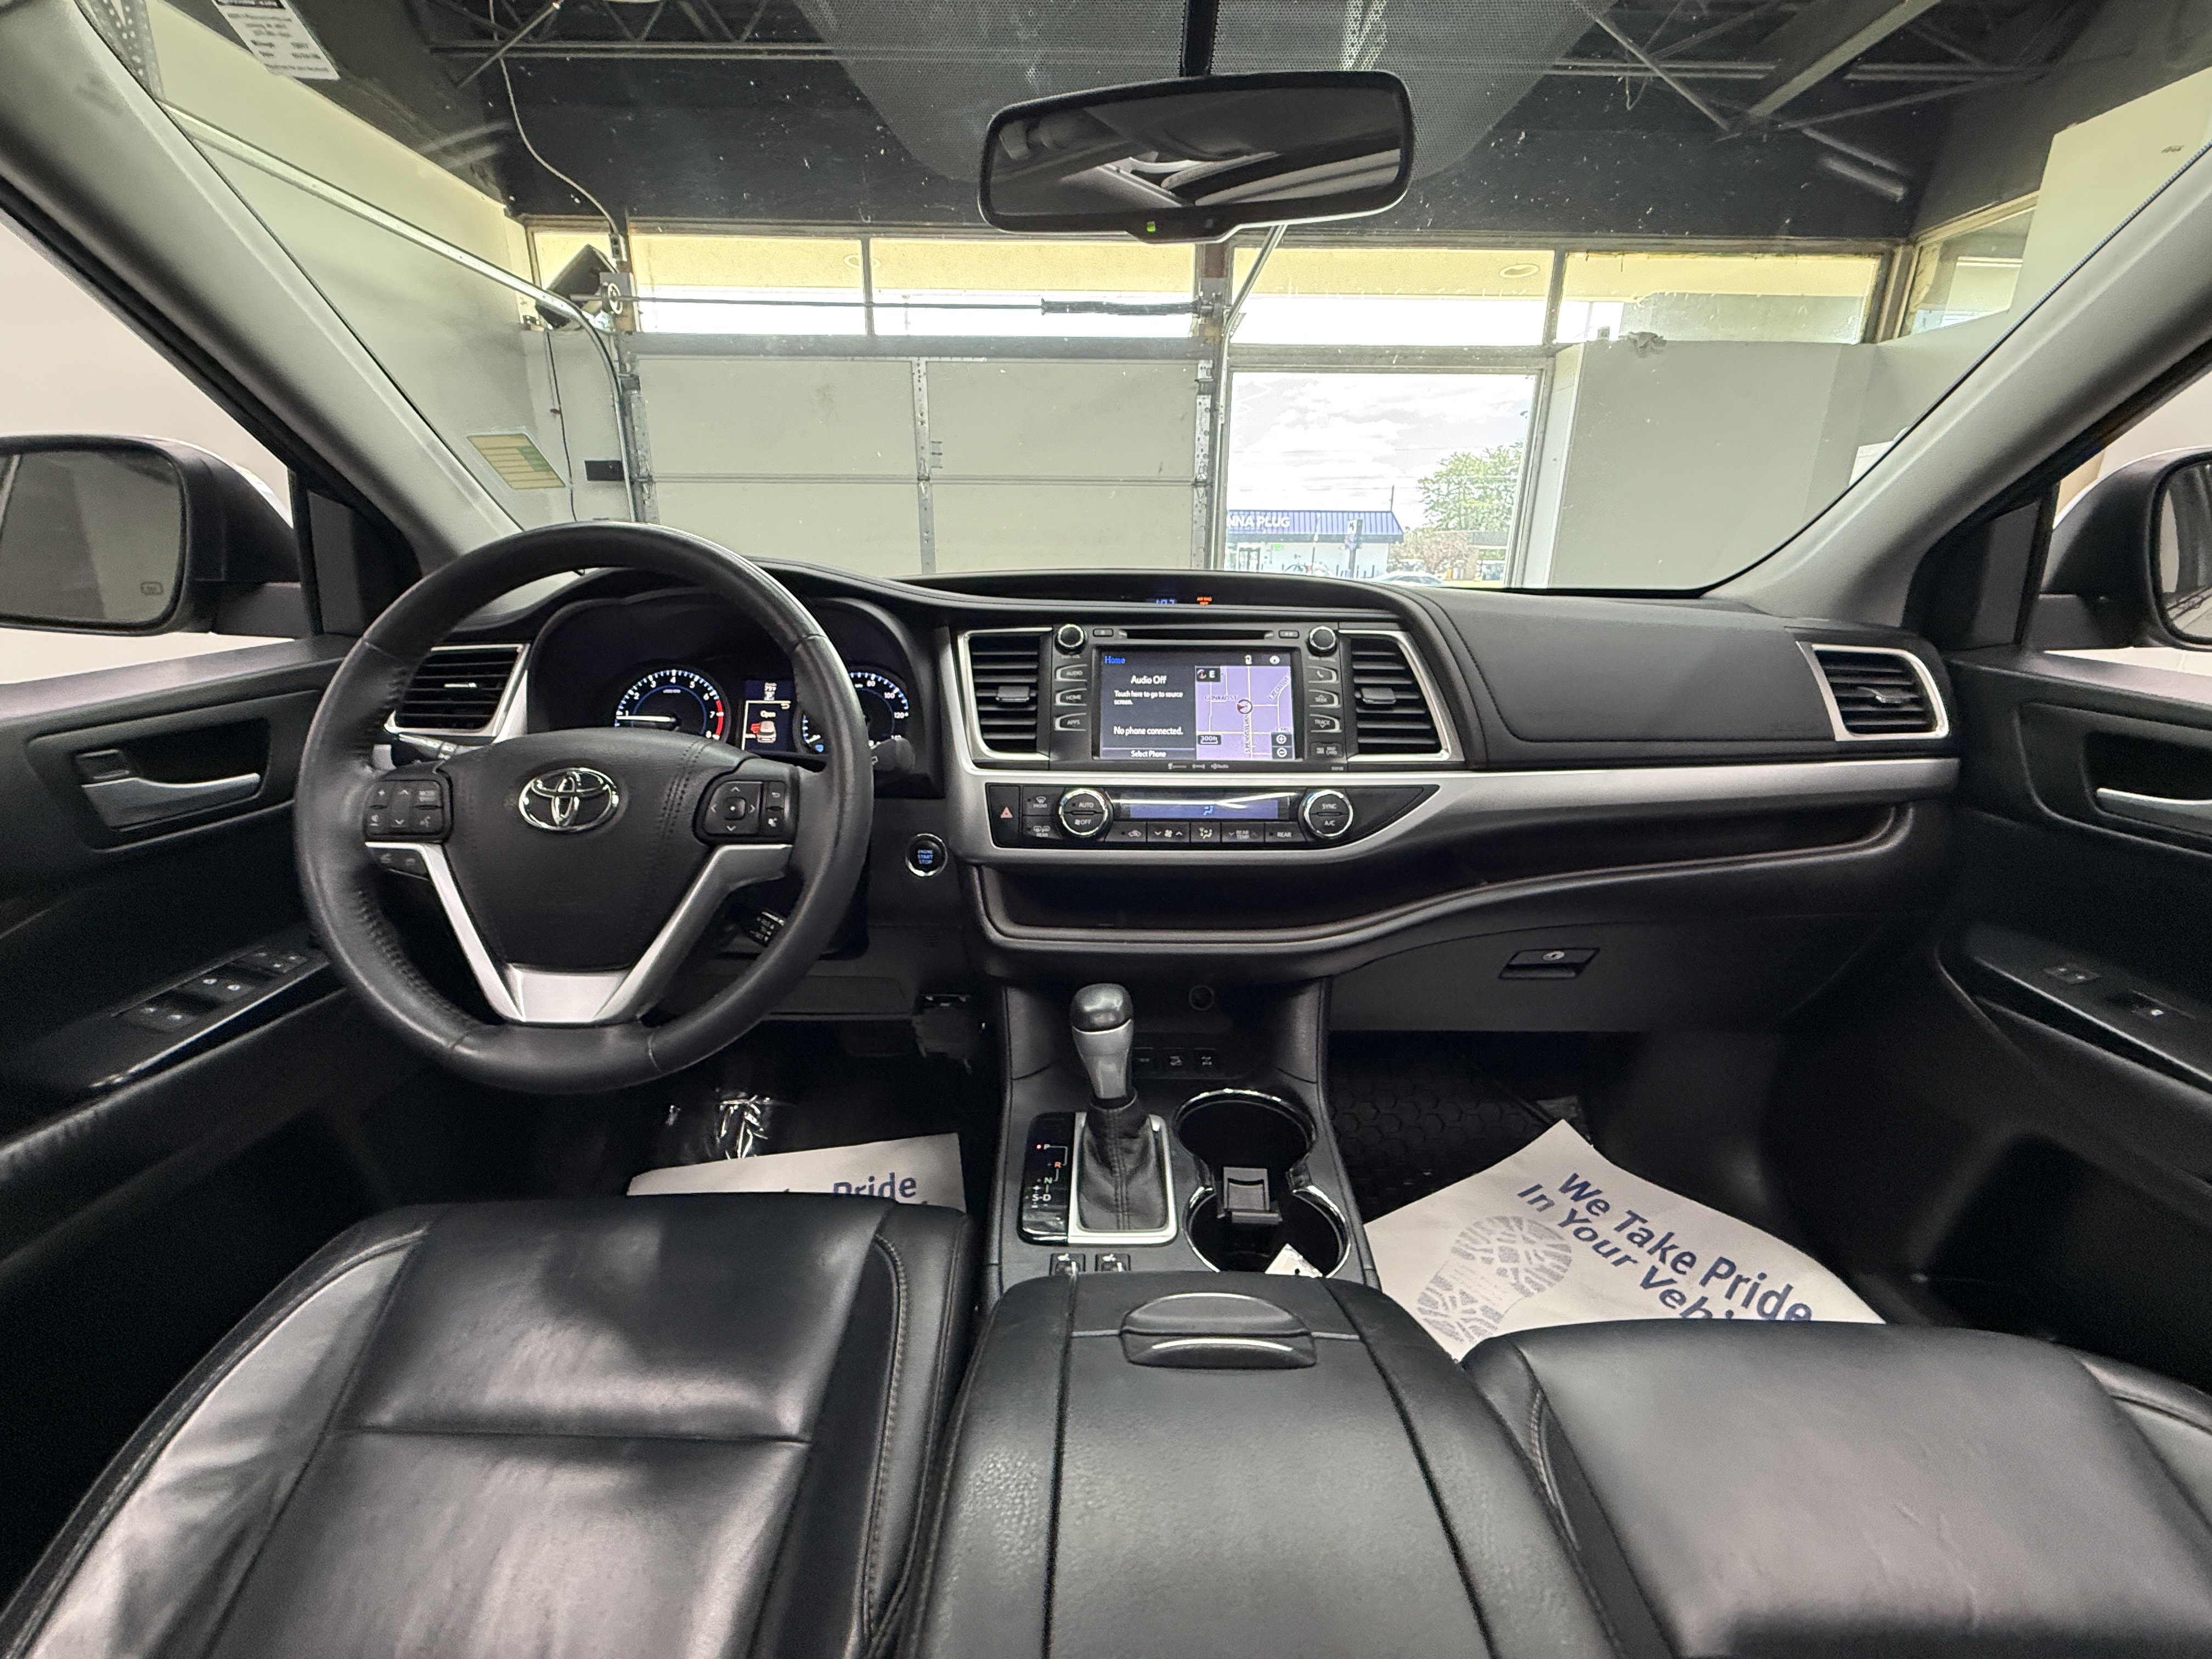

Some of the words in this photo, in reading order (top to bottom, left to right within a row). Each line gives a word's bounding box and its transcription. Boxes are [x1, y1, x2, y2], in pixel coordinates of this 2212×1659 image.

[1257, 516, 1290, 528] PLUG
[1104, 656, 1126, 664] Home
[1131, 675, 1152, 684] Audio
[1153, 675, 1167, 684] Off
[706, 730, 712, 738] 8
[1113, 726, 1125, 735] No
[1125, 726, 1146, 736] phone
[1147, 726, 1183, 735] connected.
[1517, 1183, 1556, 1212] In
[1558, 1207, 1638, 1267] Your
[1558, 1172, 1610, 1217] We
[1613, 1210, 1698, 1276] Take
[1699, 1256, 1812, 1321] Pride
